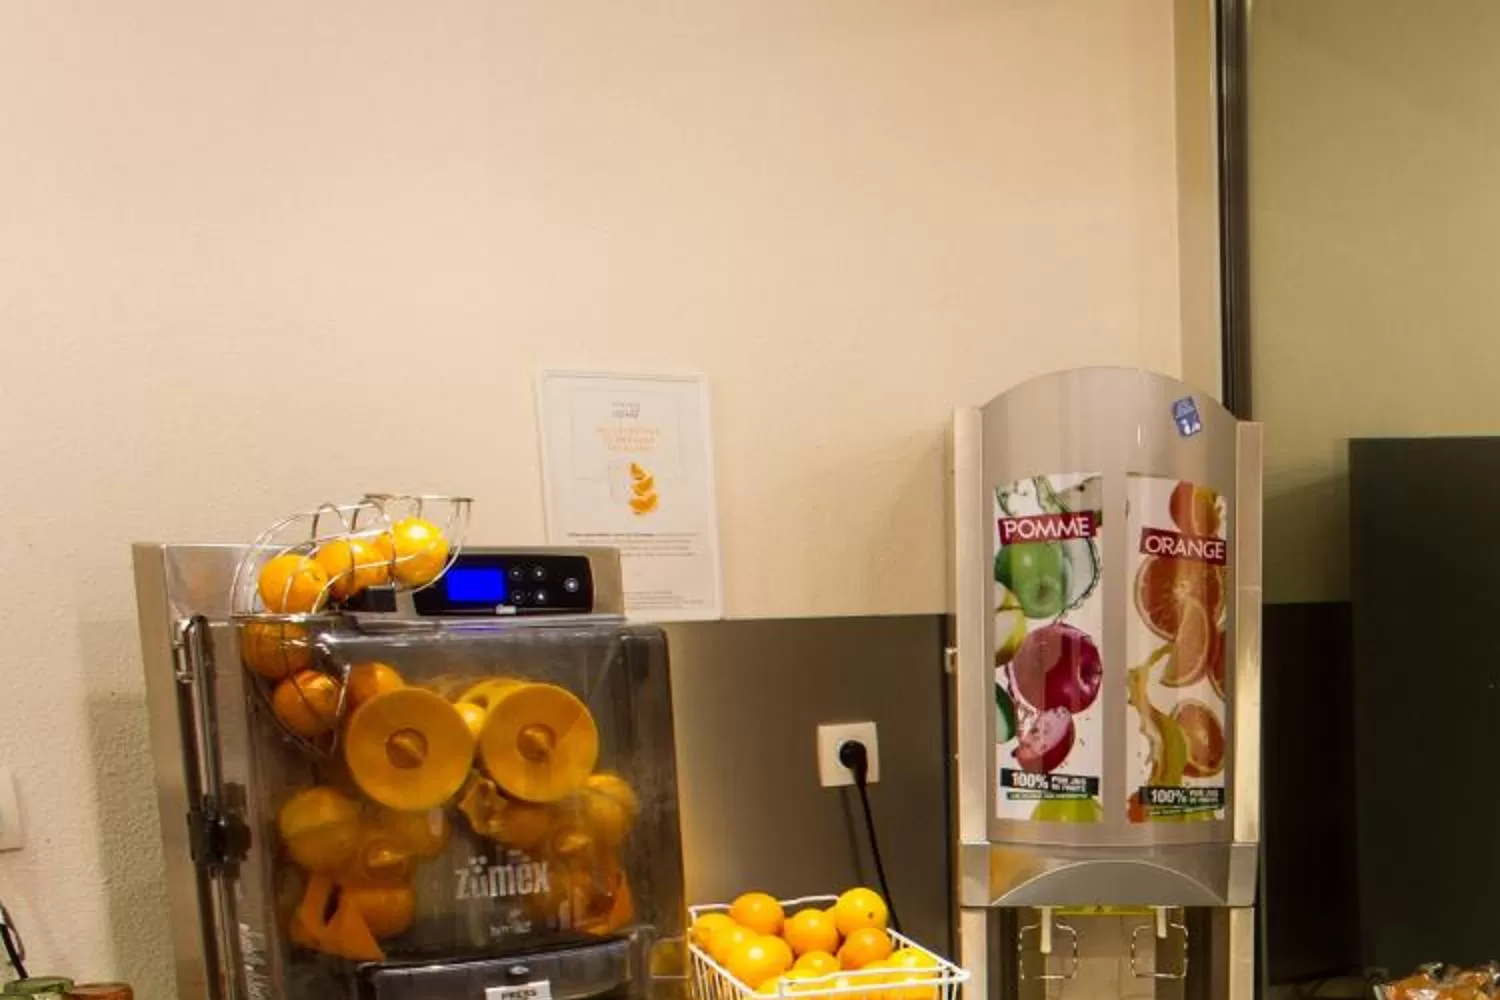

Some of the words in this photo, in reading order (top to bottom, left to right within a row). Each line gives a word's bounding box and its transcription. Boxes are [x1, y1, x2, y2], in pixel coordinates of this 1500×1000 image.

[1004, 517, 1091, 539] POMME
[1144, 535, 1224, 559] ORANGE
[1011, 771, 1049, 789] 100%
[1151, 789, 1187, 803] 100%
